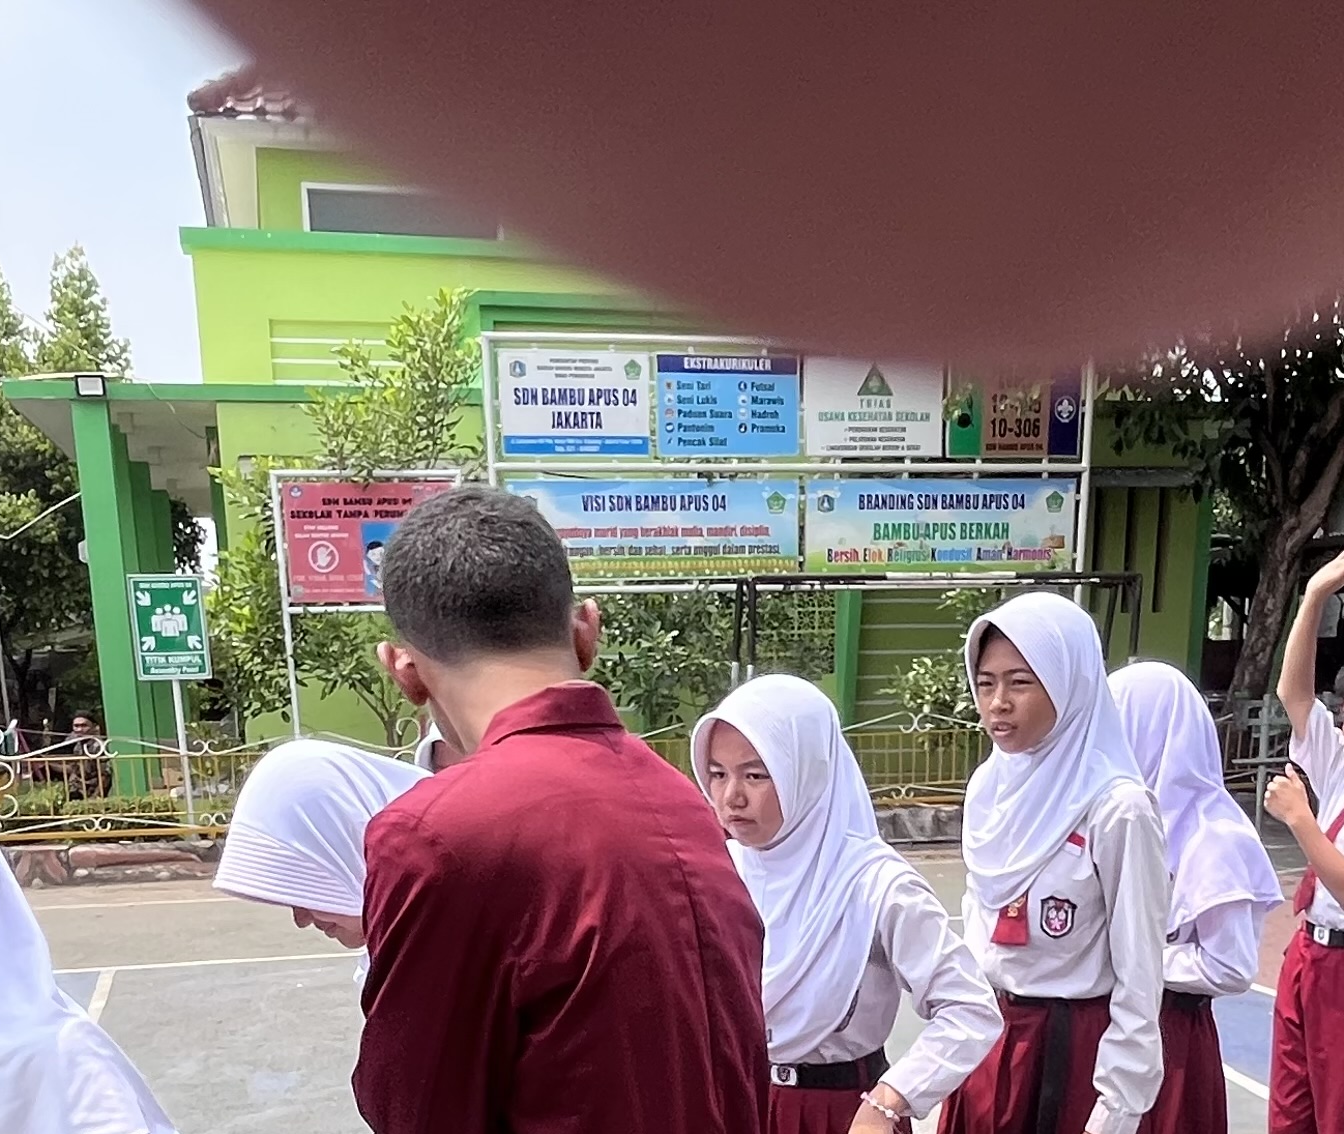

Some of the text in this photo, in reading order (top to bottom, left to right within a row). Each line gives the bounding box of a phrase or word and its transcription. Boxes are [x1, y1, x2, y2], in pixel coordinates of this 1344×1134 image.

[683, 357, 772, 371] EKSTRAKURIKULER
[750, 381, 776, 391] Futsal
[513, 387, 638, 407] SDN BAMBU APUS 04
[696, 394, 718, 405] Lukis
[551, 411, 603, 430] JAKARTA
[990, 418, 1041, 438] 10-306
[677, 437, 707, 447] Pencak
[582, 494, 727, 512] VISI SDN BAMBU APUS 04
[858, 493, 1025, 511] BRANDING SDN BAMBU APUS 04
[290, 510, 333, 519] SEKOLAH
[873, 522, 1010, 541] BAMBU APUS BERKAH
